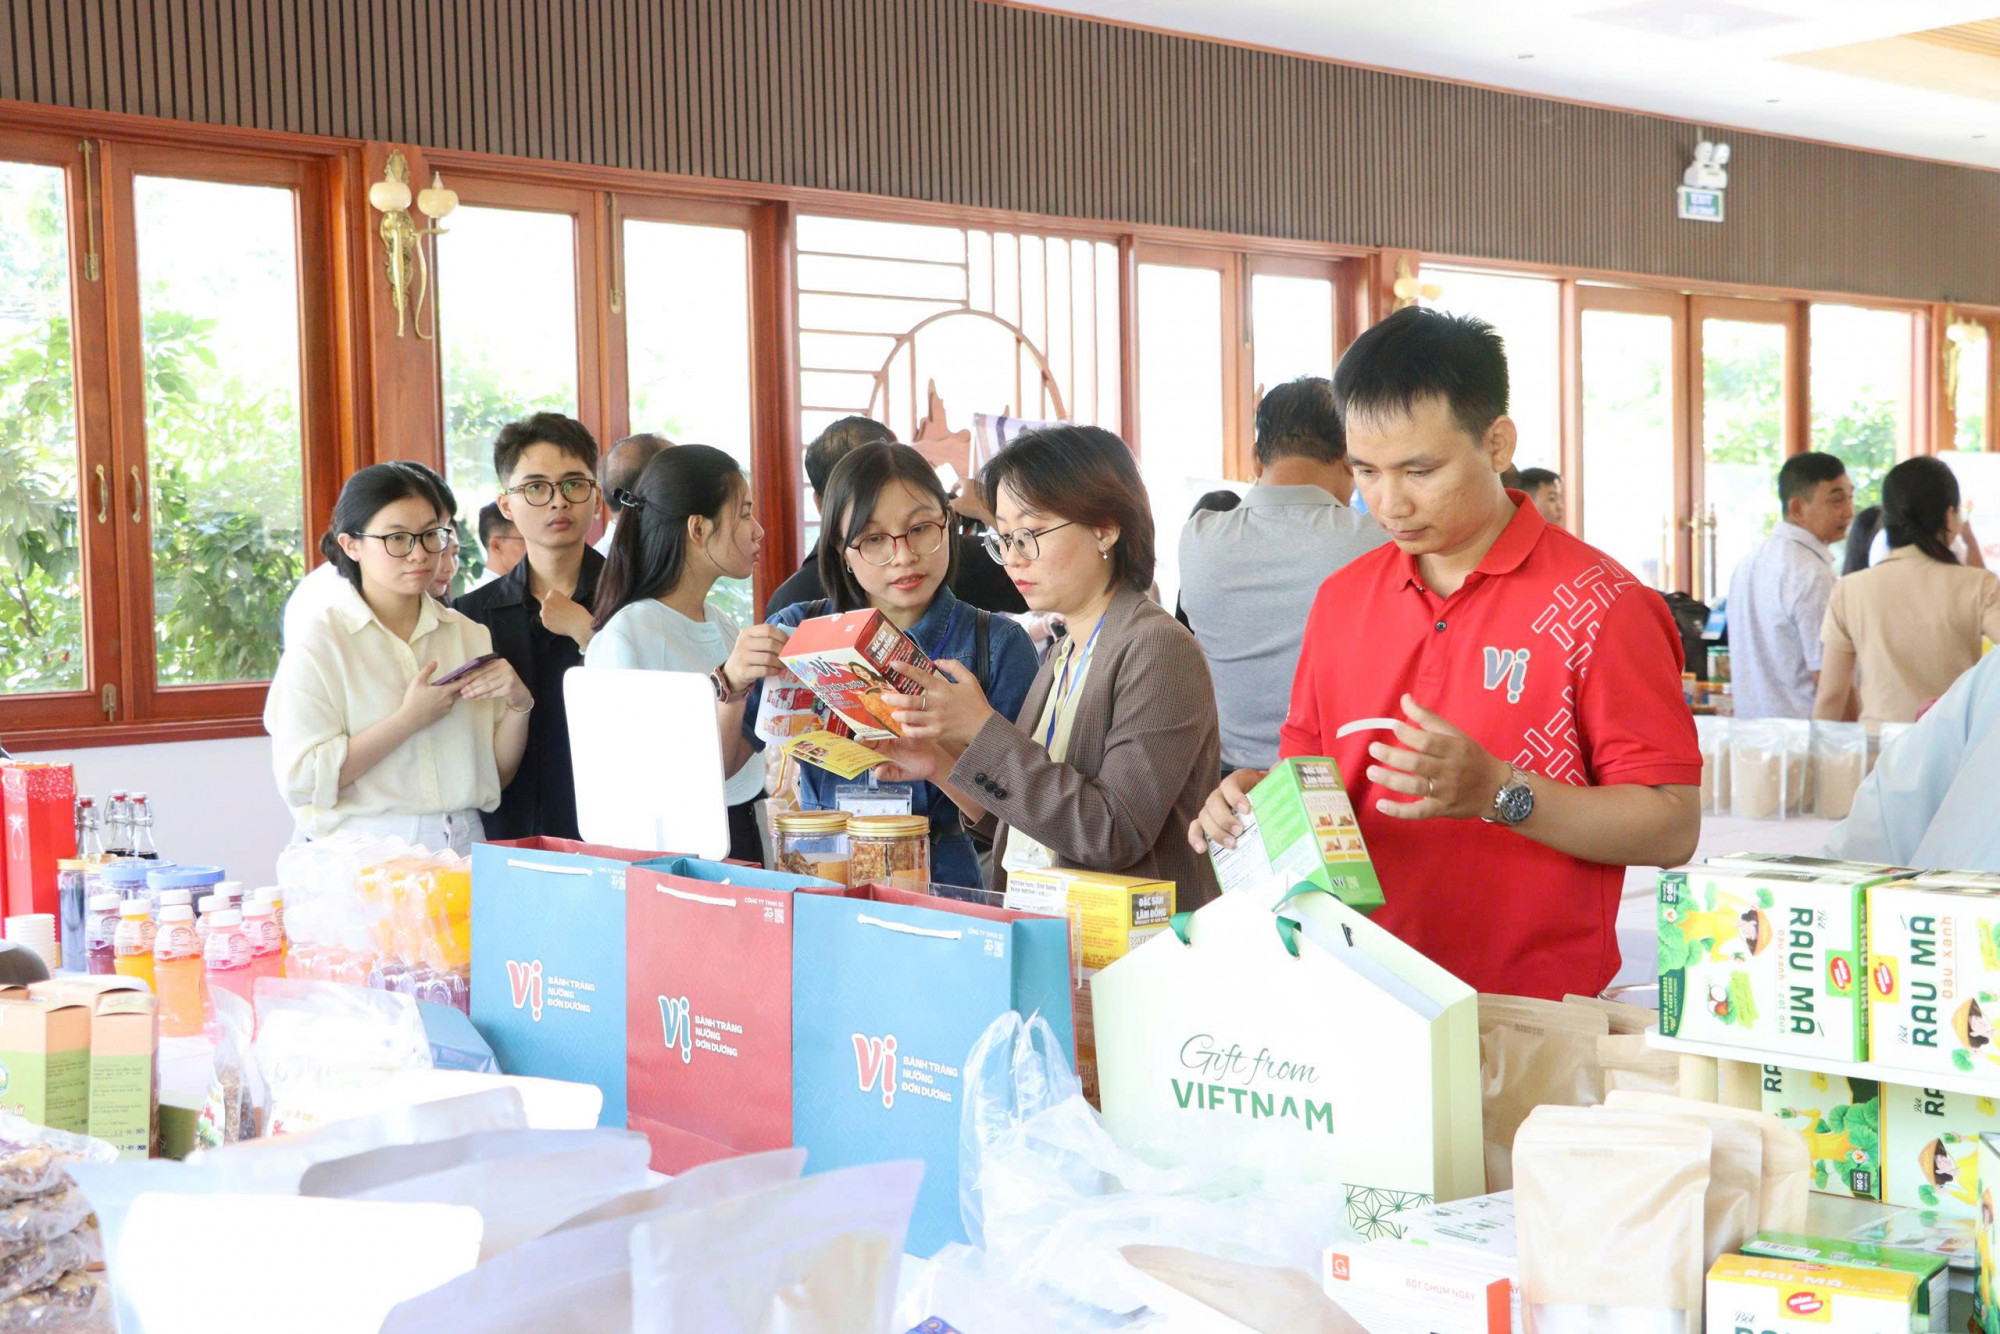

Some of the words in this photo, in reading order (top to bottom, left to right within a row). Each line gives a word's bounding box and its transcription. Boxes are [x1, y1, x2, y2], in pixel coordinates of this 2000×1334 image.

[1482, 646, 1531, 704] Vị
[1789, 907, 1815, 972] RAU
[1900, 914, 1936, 967] MÁ
[506, 959, 543, 1021] Vị
[1790, 985, 1825, 1038] MÁ
[1910, 981, 1938, 1048] RAU
[658, 994, 692, 1064] Vị
[850, 1032, 898, 1110] Vị
[1180, 1034, 1249, 1081] Gift
[1243, 1047, 1320, 1085] from
[1764, 1063, 1782, 1093] RA
[1923, 1087, 1945, 1117] RA
